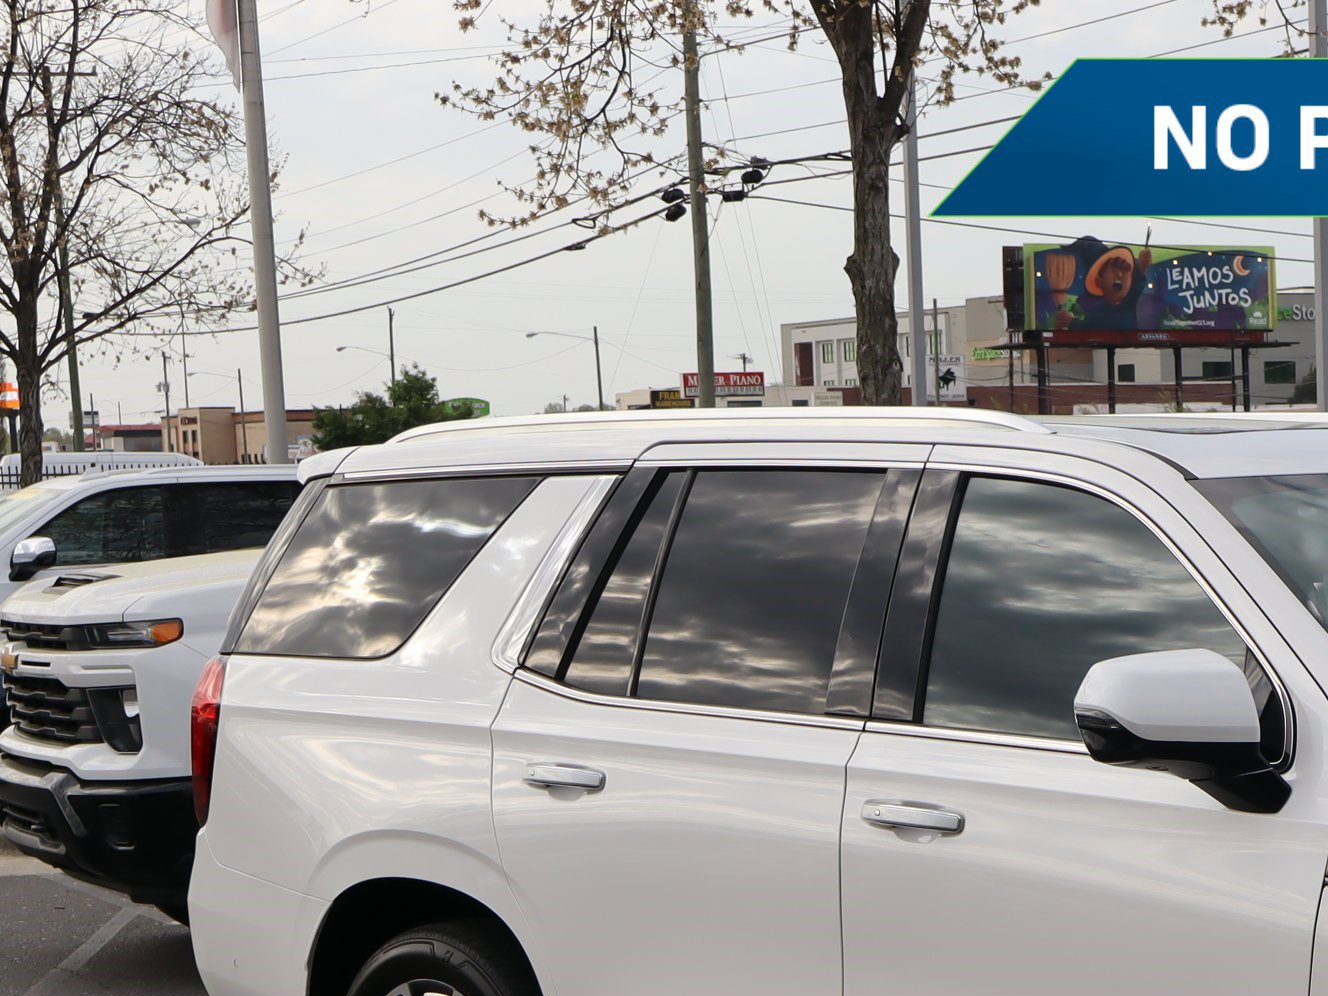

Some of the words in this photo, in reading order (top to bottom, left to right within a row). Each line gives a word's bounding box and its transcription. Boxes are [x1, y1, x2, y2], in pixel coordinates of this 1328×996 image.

[928, 356, 961, 364] MLLER
[687, 375, 726, 386] MER
[729, 374, 761, 386] PIANO
